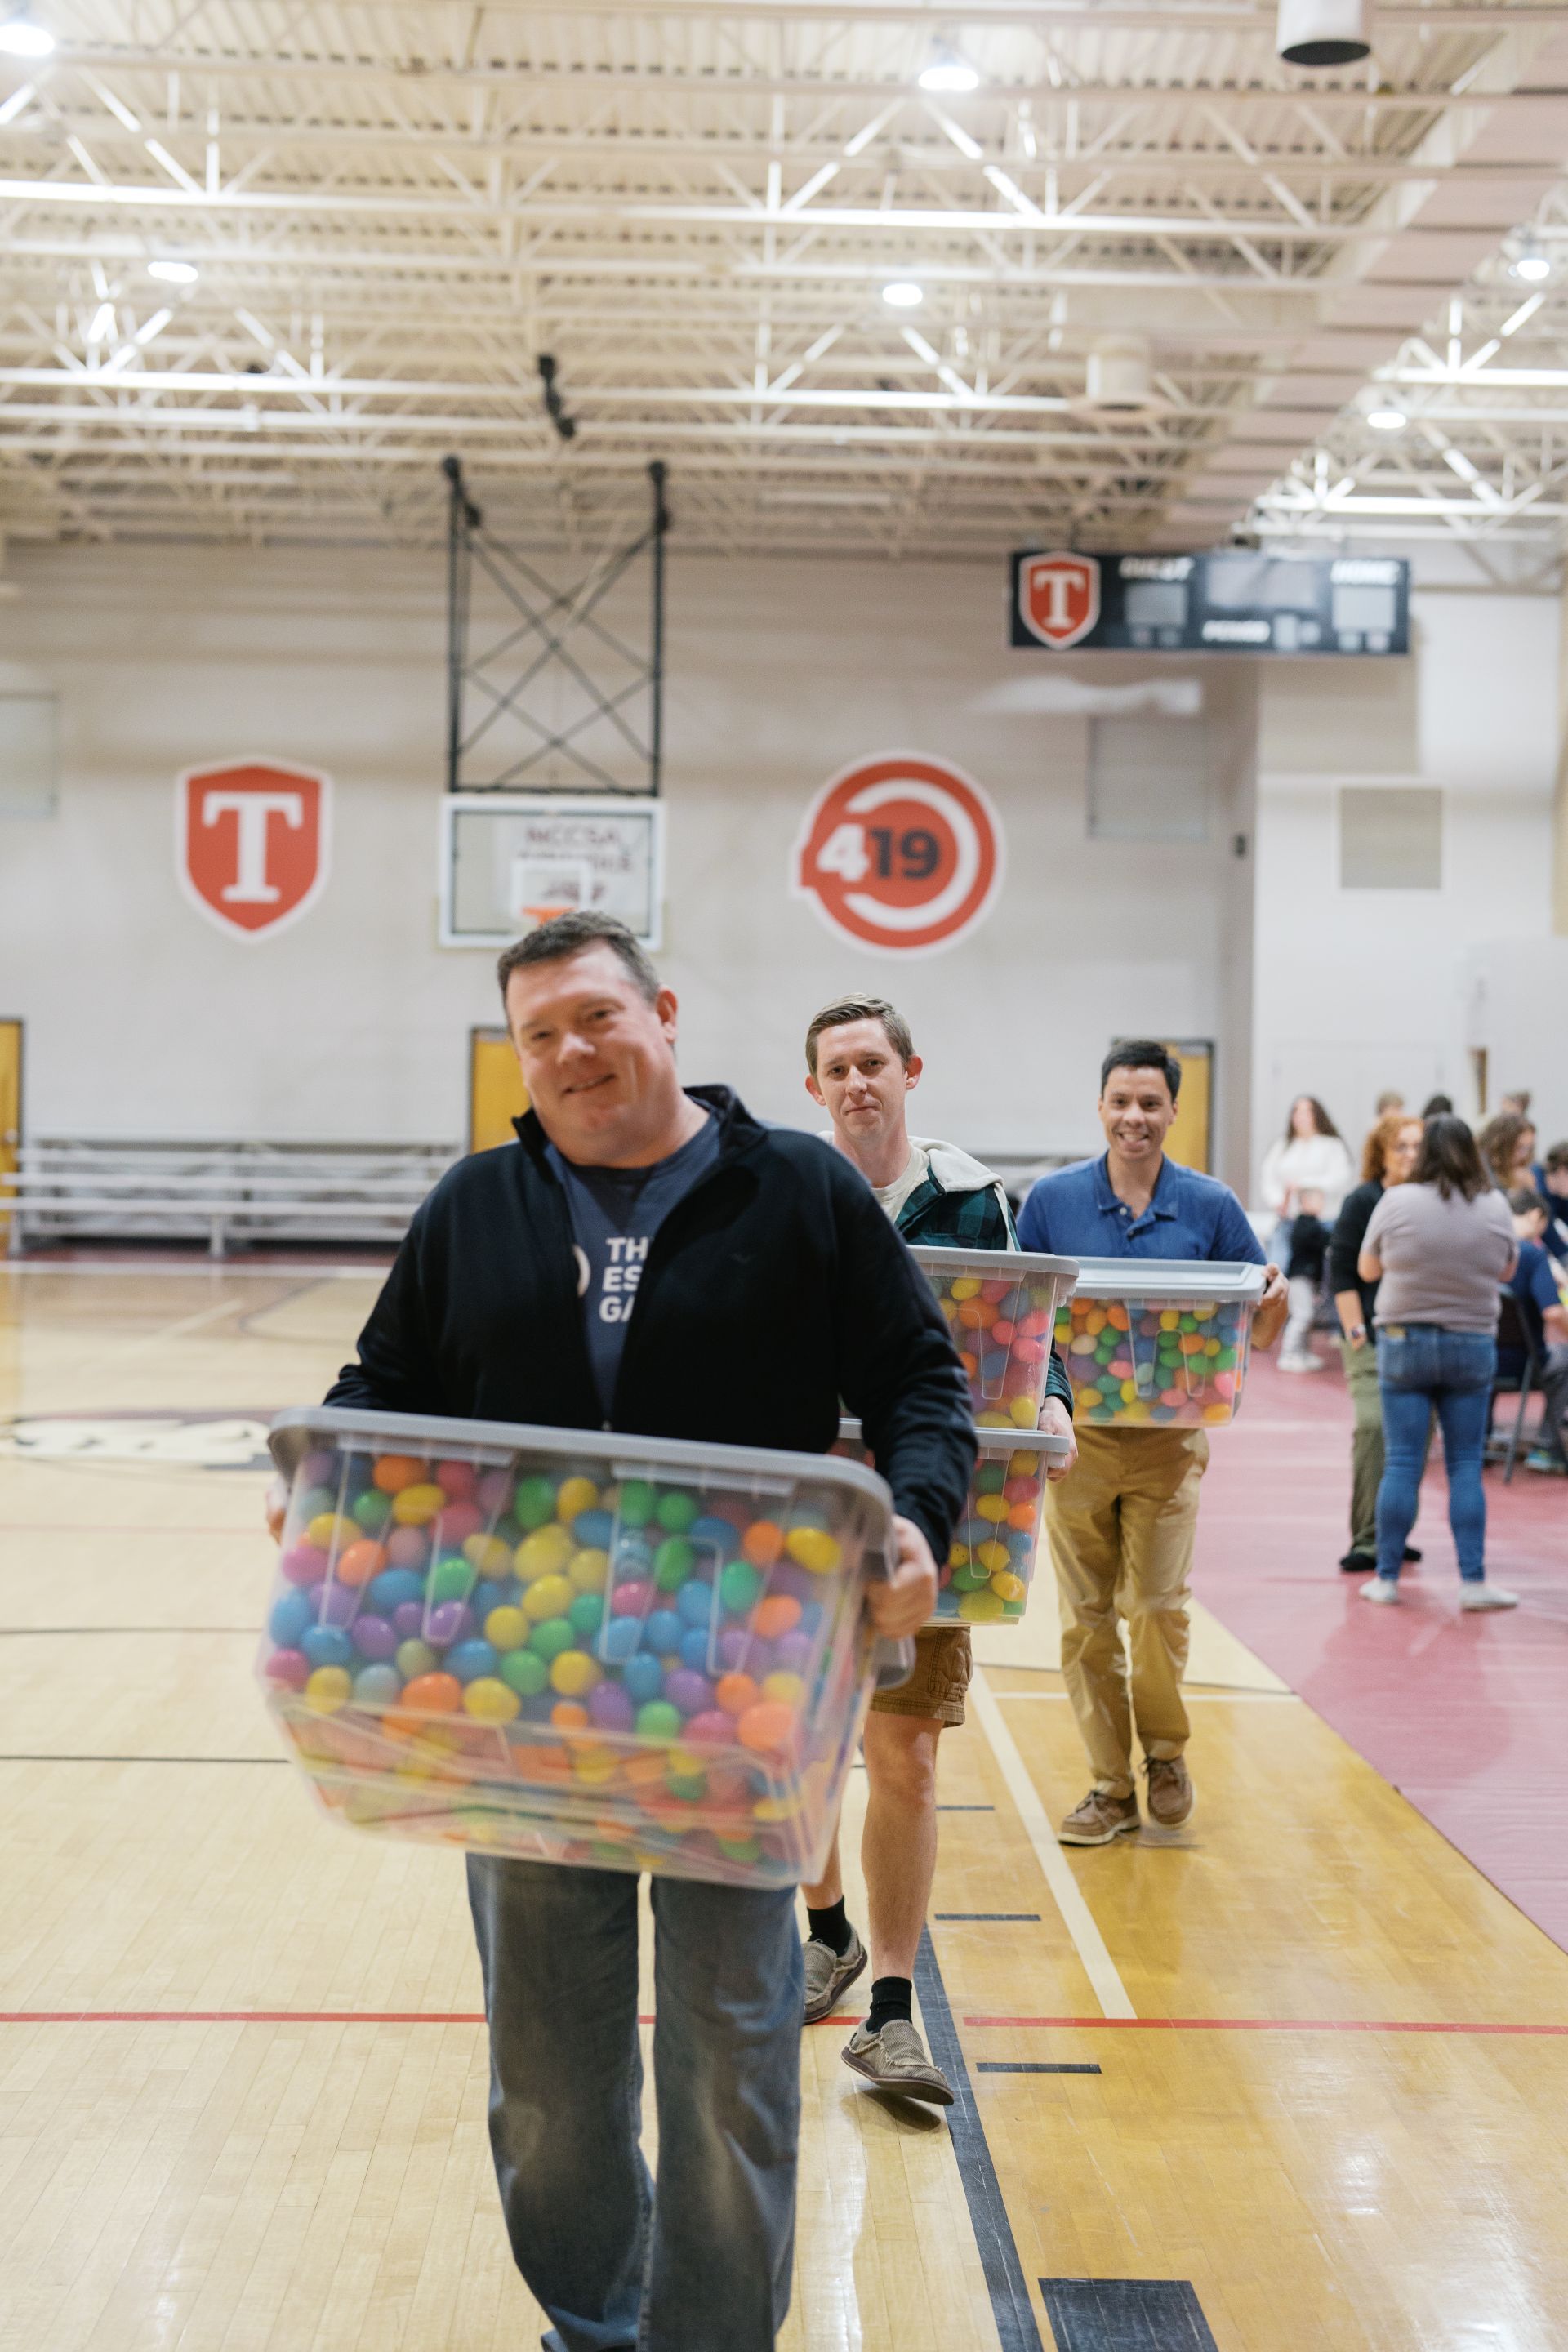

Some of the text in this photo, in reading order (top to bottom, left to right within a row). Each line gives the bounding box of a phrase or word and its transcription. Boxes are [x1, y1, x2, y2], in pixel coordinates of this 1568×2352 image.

[1034, 570, 1086, 628] T
[202, 792, 303, 902] T
[816, 822, 941, 882] 419
